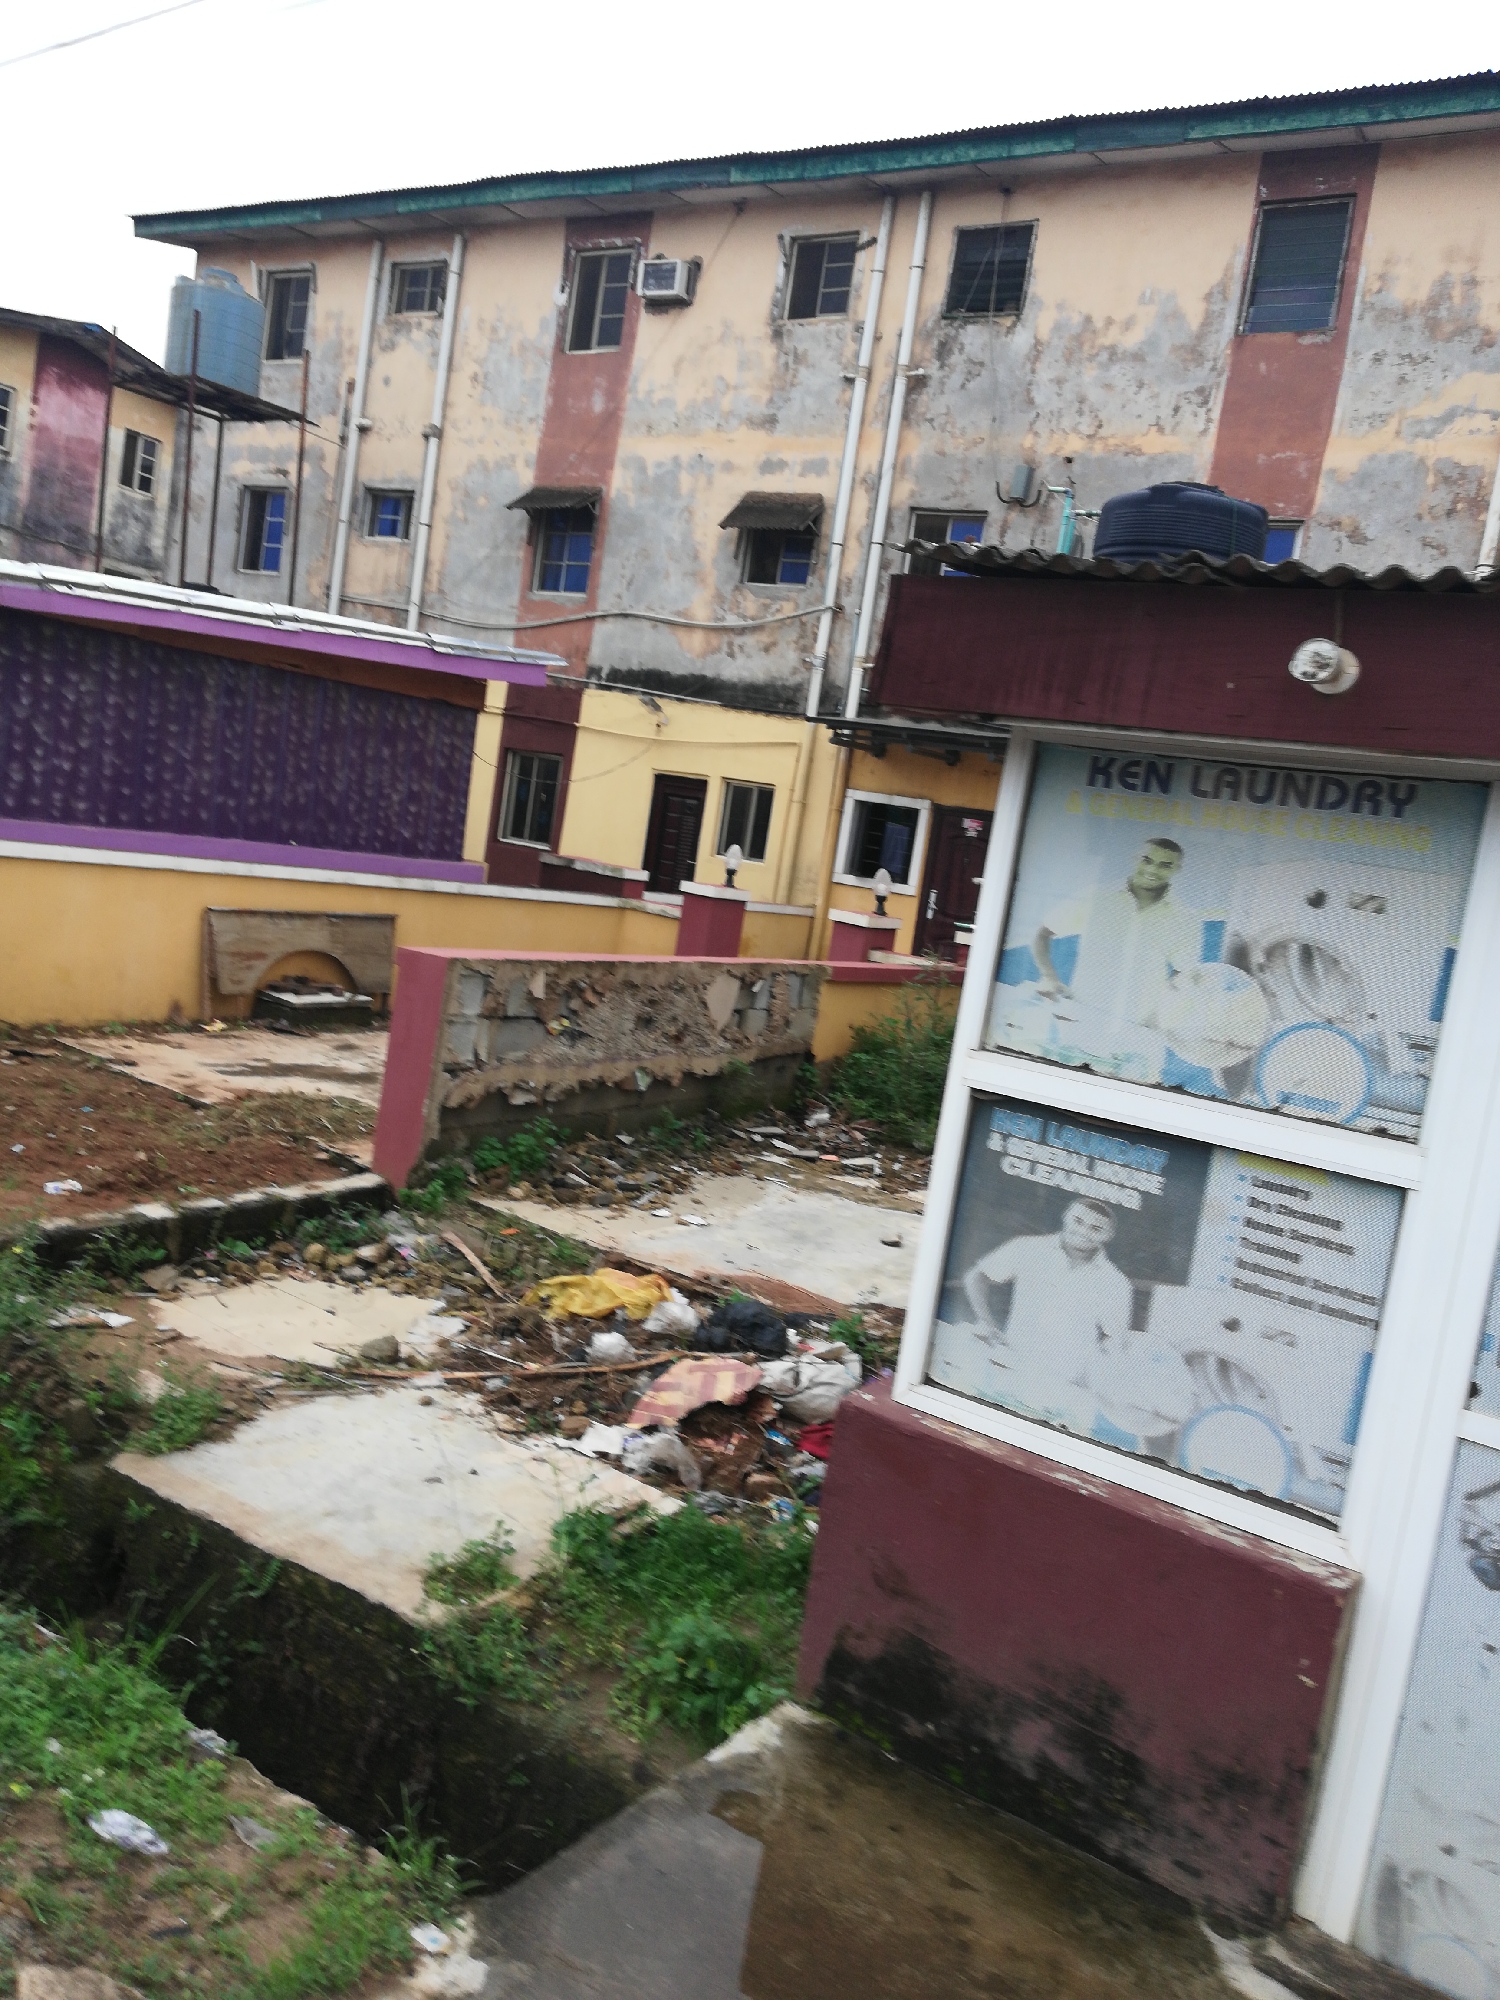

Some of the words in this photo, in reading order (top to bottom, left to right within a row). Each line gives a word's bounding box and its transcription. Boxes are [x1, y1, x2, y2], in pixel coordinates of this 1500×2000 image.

[1086, 755, 1175, 796] KEN
[1189, 764, 1418, 819] LAUNDRY
[1065, 789, 1083, 815] &
[1088, 792, 1194, 827] GENERAL
[1201, 803, 1288, 837] HOUSE
[1294, 813, 1432, 852] CLEANING
[989, 1106, 1044, 1143] KEN
[1045, 1120, 1170, 1174] LAUNDRY
[1005, 1136, 1090, 1177] GENERAL
[1092, 1158, 1167, 1197] HOUSE
[1000, 1154, 1142, 1210] CLEANING
